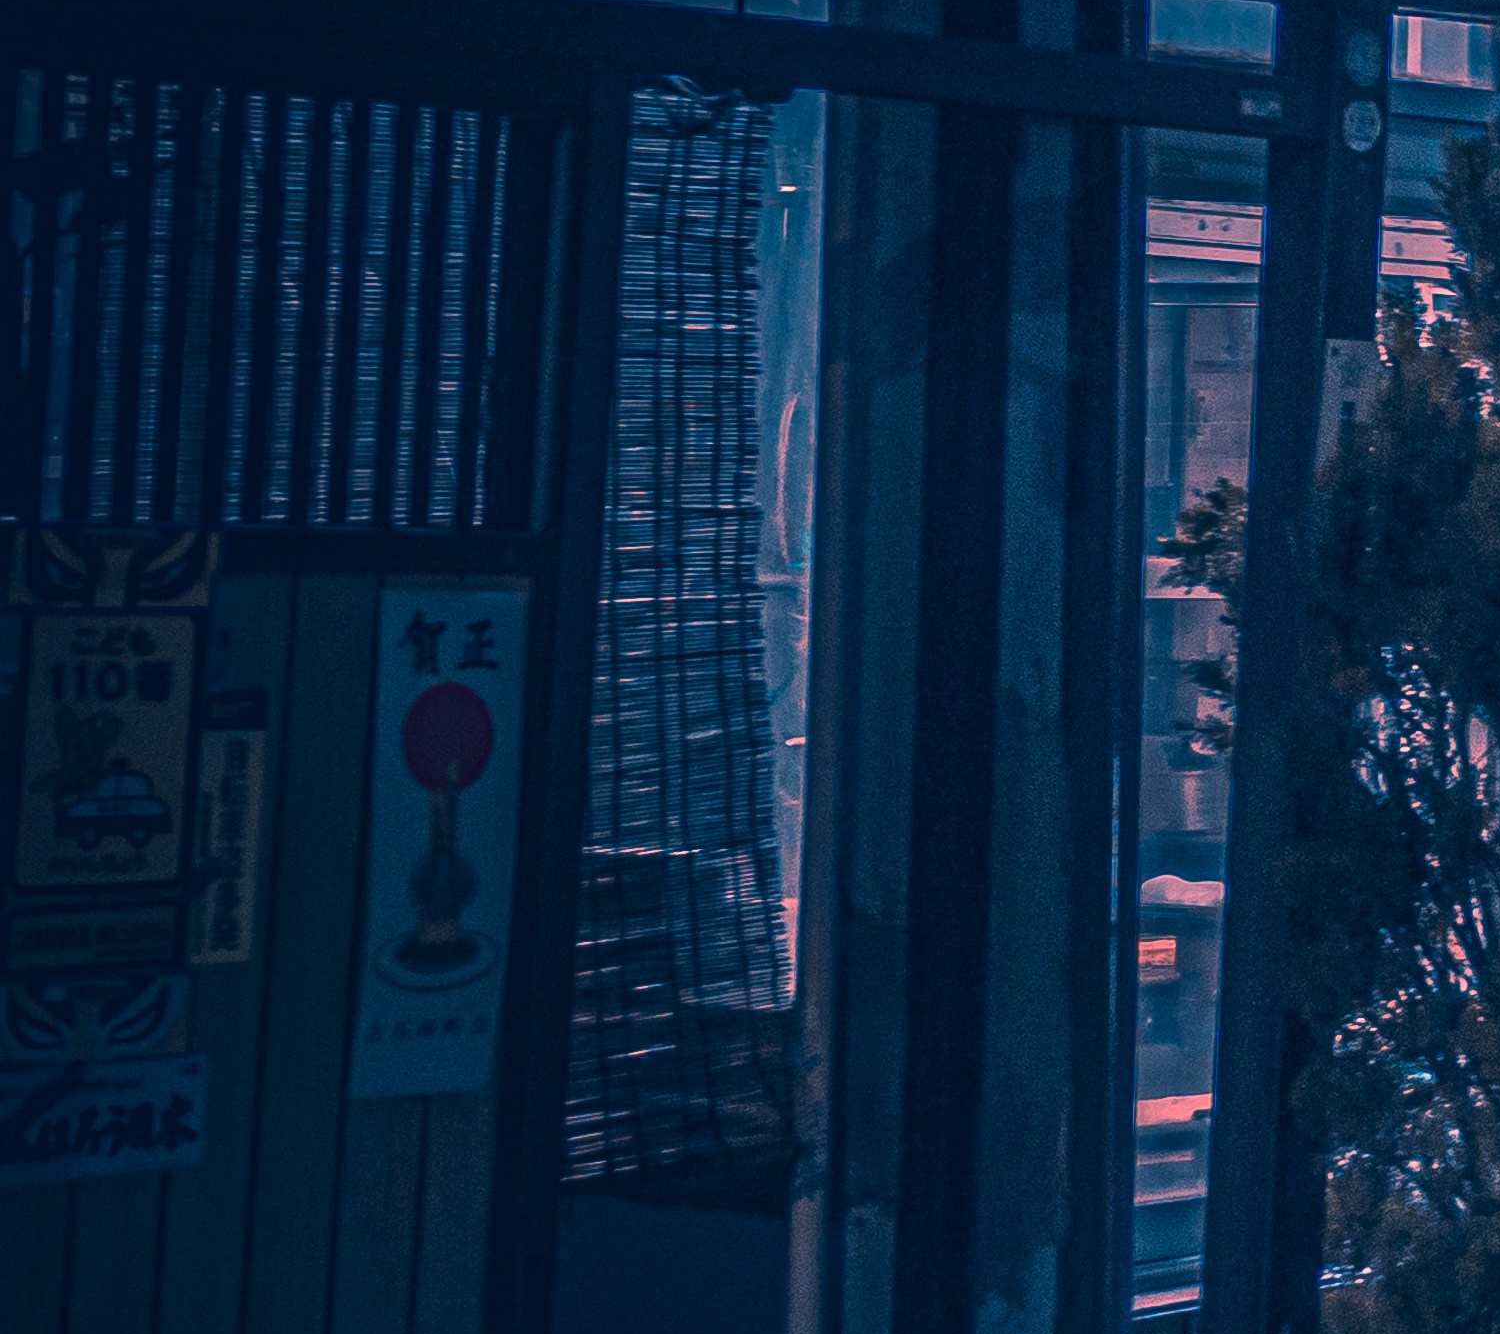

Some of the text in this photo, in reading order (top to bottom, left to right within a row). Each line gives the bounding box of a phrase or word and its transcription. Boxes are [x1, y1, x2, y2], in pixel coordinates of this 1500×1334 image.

[70, 625, 156, 656] こども
[399, 610, 500, 674] 賀正
[47, 660, 175, 702] 110番
